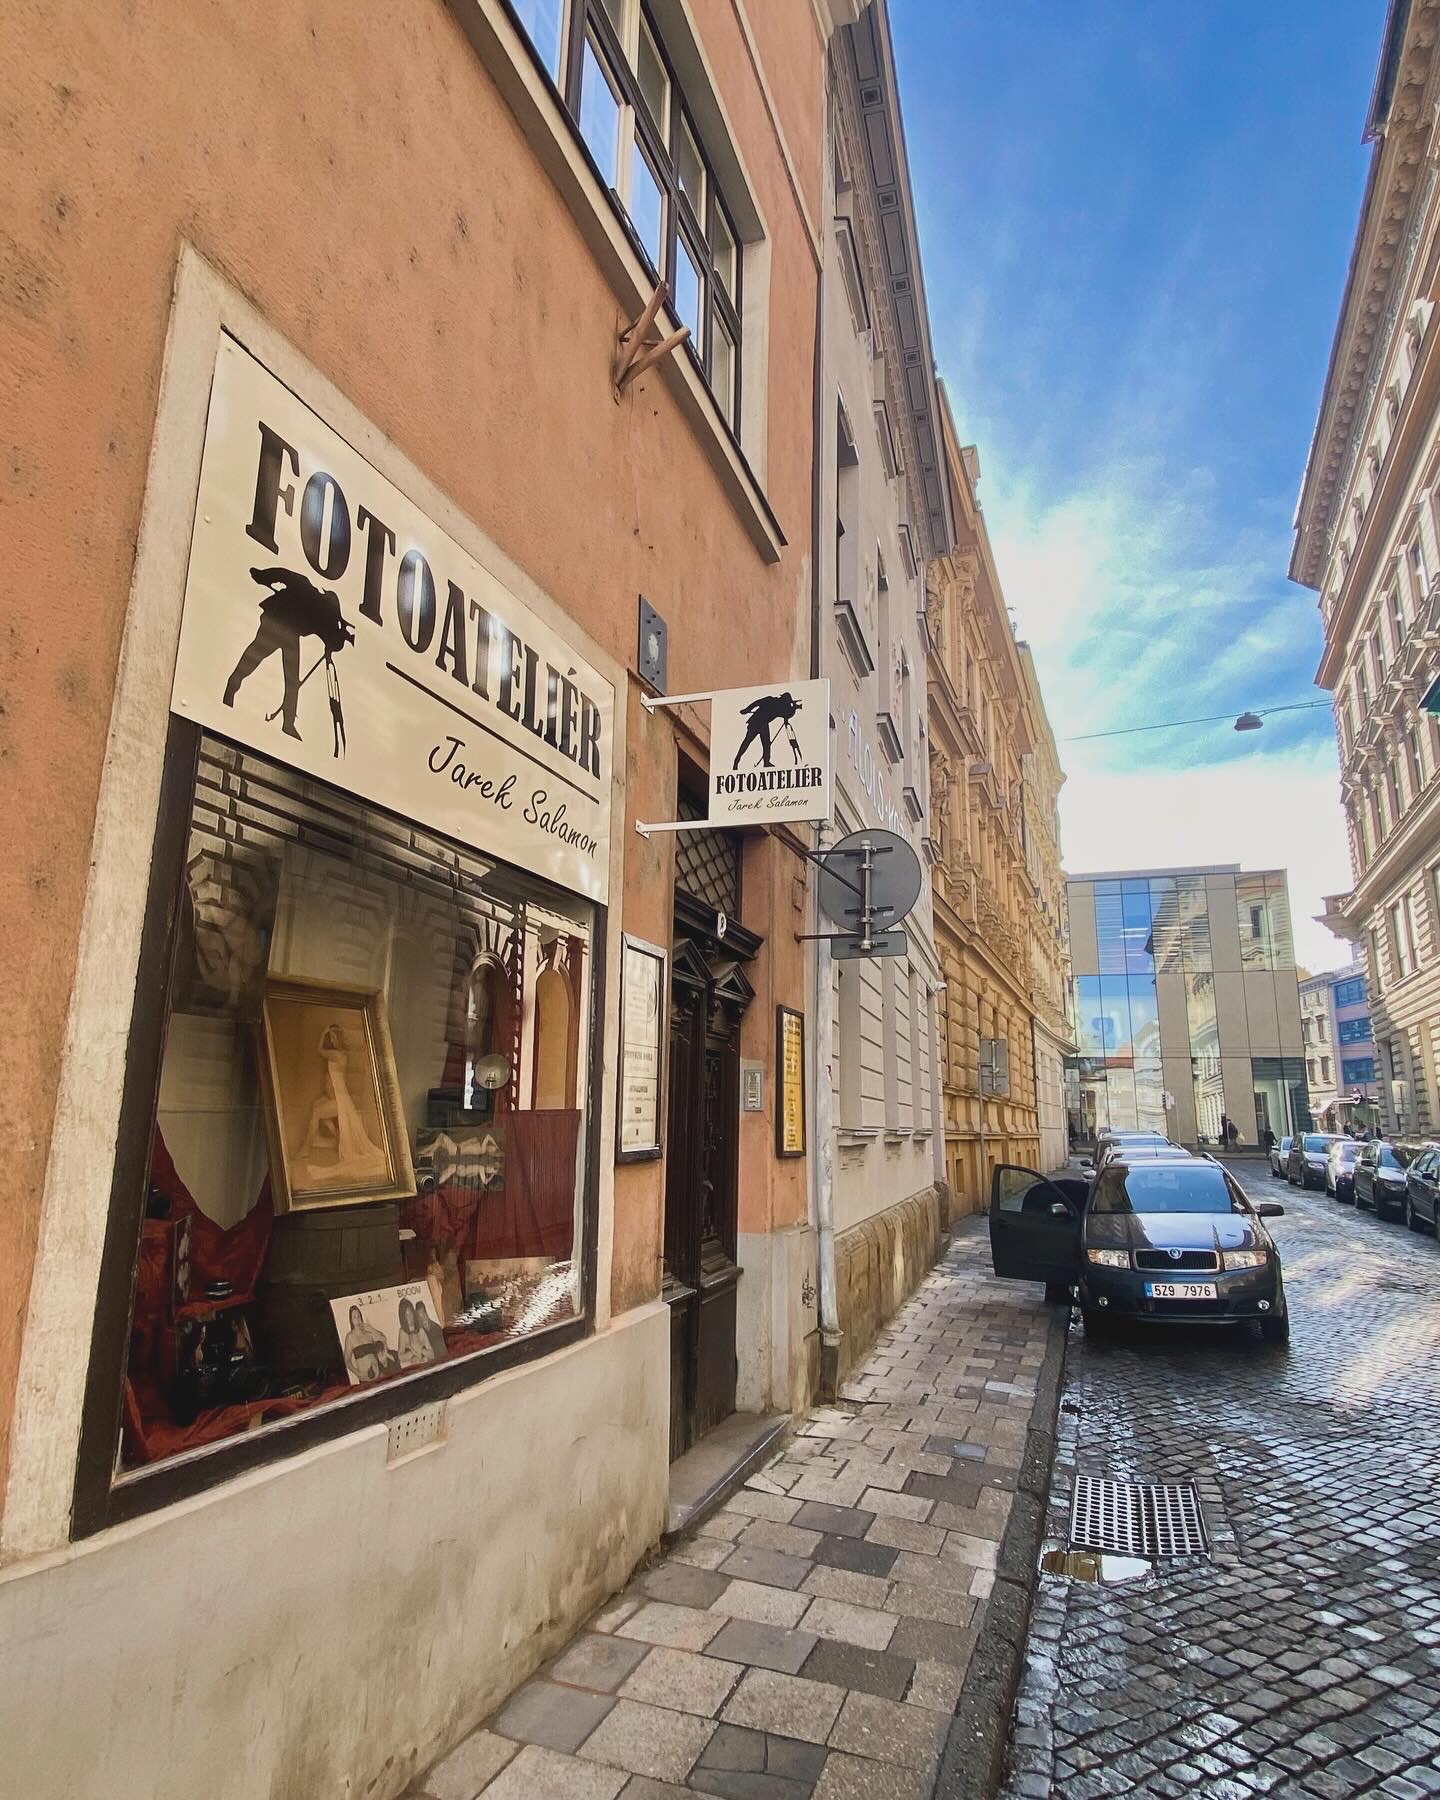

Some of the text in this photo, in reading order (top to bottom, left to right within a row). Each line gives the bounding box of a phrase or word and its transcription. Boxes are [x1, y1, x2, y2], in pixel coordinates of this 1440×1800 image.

[246, 421, 601, 780] FOTOATELIÉR
[716, 764, 822, 794] FOTOATELIÉR
[428, 736, 598, 859] Jarek Salamon
[728, 796, 809, 811] Jarek Salamon
[1154, 1285, 1211, 1297] 5Z9 7976
